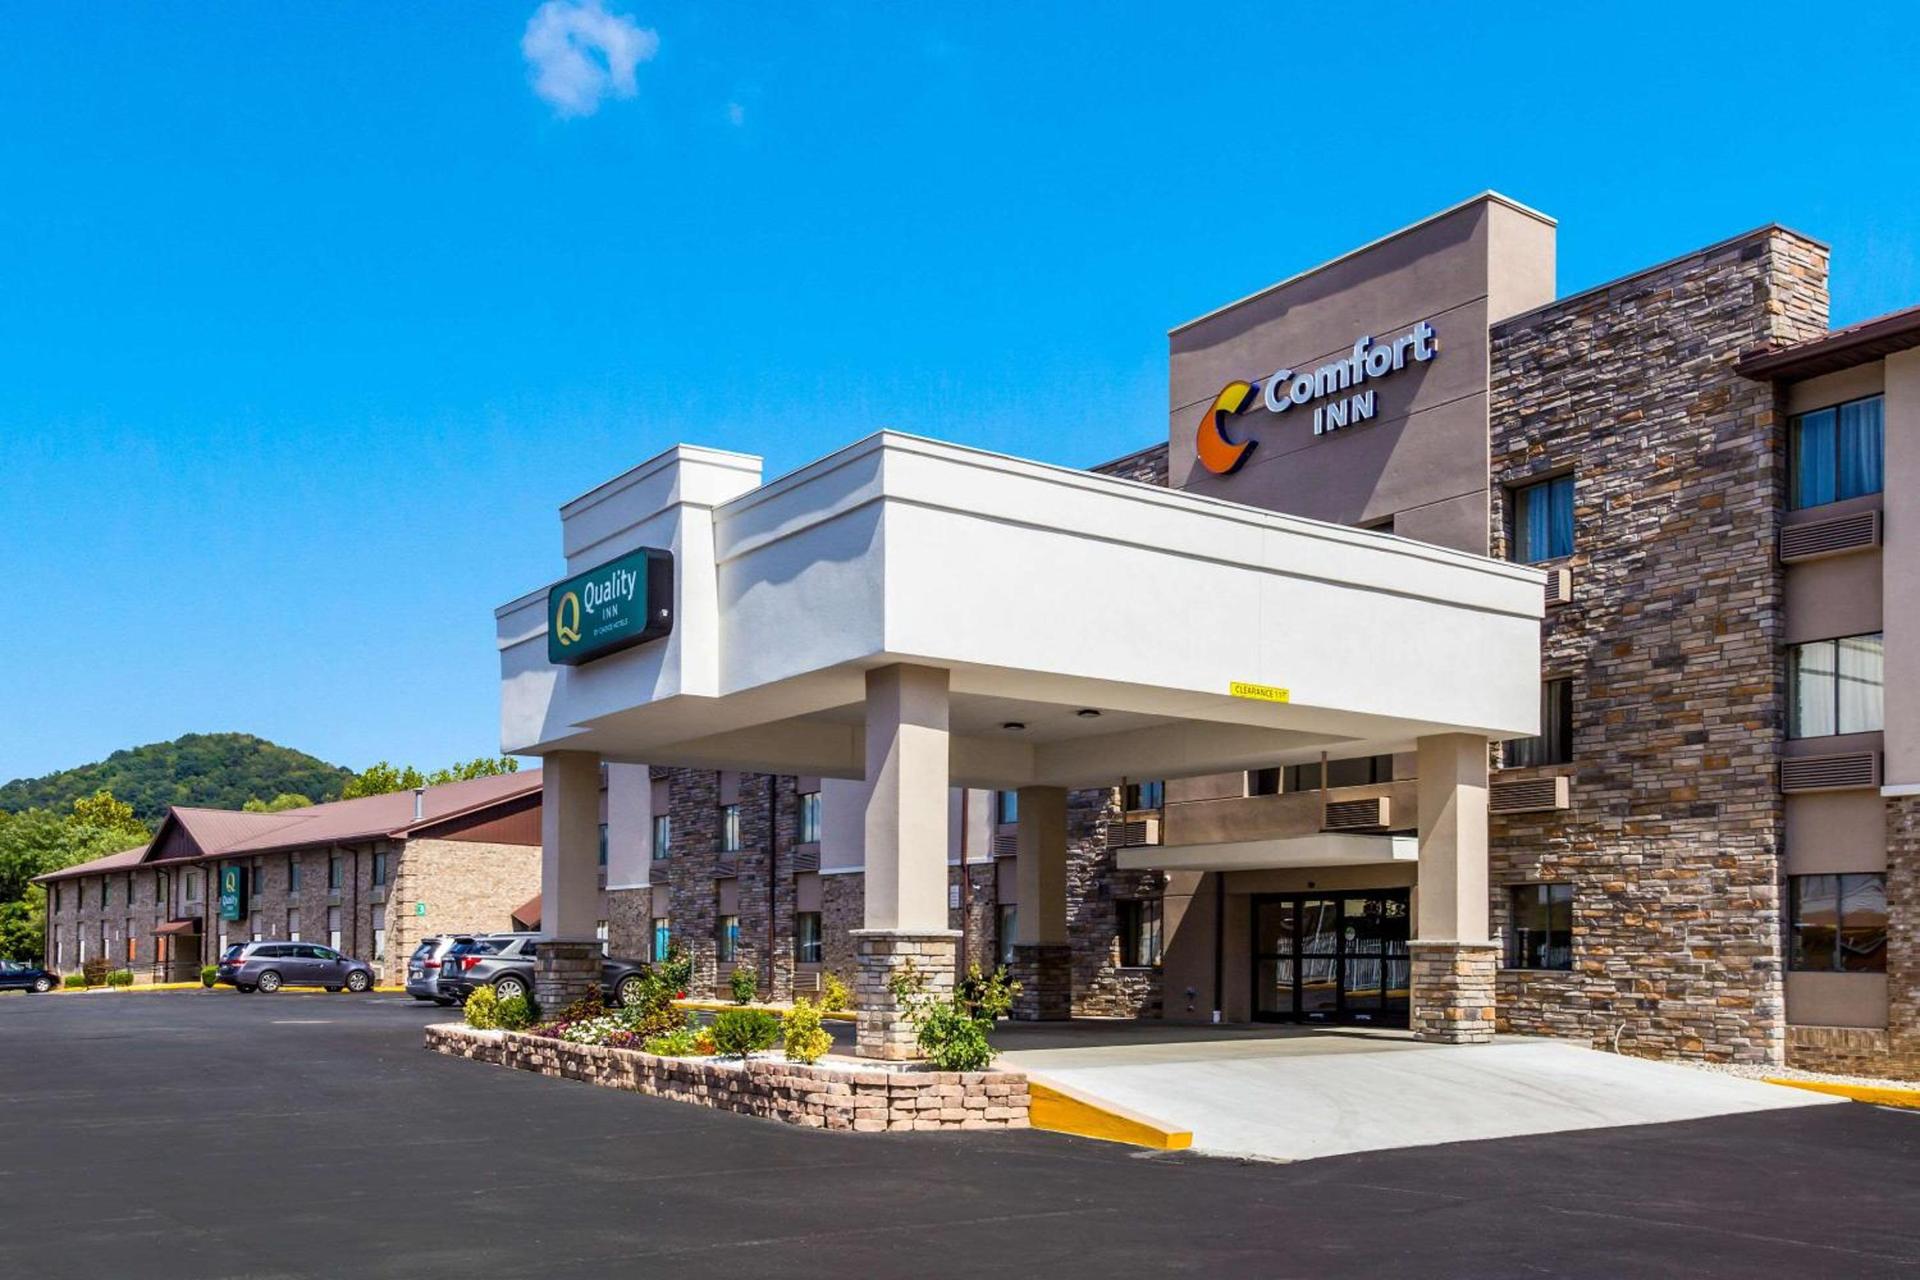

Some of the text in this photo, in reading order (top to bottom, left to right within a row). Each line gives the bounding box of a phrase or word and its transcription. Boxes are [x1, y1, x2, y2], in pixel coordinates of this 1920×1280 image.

[1264, 321, 1435, 413] Comfort
[1313, 389, 1376, 436] INN
[584, 569, 637, 614] Quality
[602, 604, 619, 621] INN
[556, 591, 581, 646] Q
[1235, 684, 1273, 698] CLEARANCE
